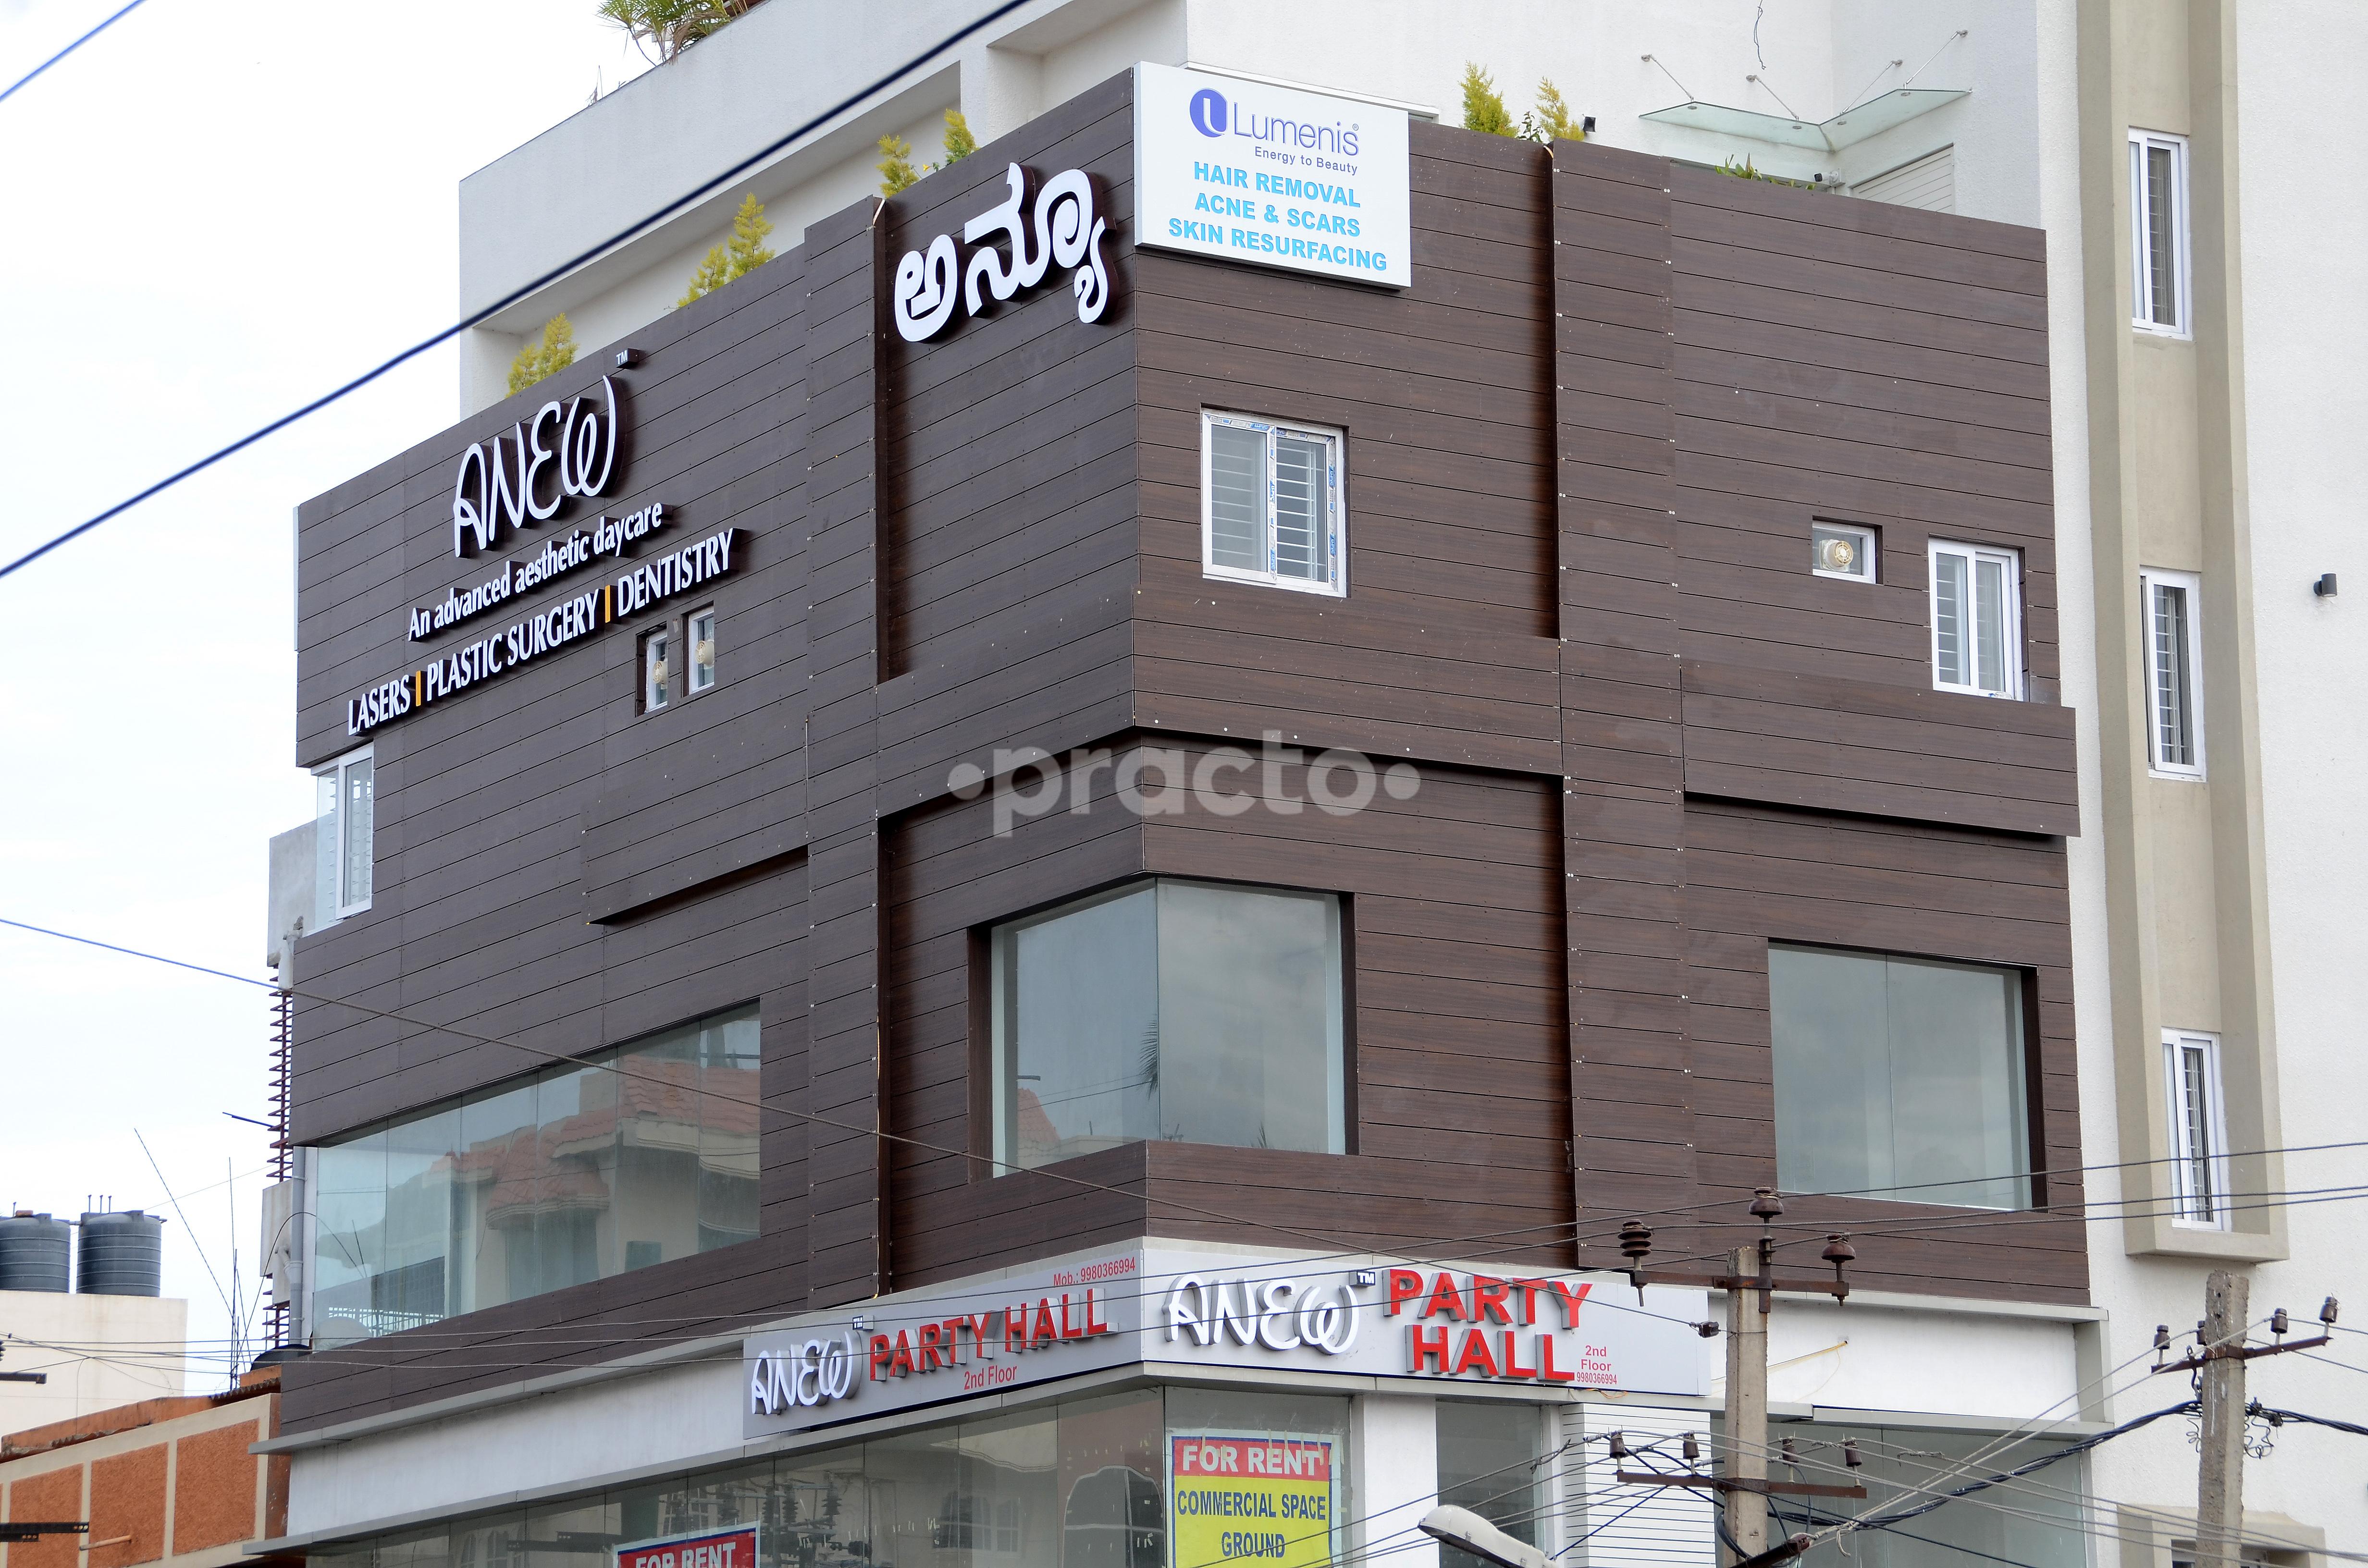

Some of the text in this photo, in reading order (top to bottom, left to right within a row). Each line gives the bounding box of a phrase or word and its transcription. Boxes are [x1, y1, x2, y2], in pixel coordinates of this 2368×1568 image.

[1255, 147, 1357, 176] Energy to Beauty
[1194, 161, 1360, 208] HAIR REMOVAL
[1194, 193, 1360, 237] ACNE & SCARS
[1169, 218, 1387, 271] SKIN RESURFACING
[453, 375, 616, 558] ANEW
[408, 502, 662, 641] An advanced aesthetic daycare
[348, 527, 733, 736] LASERS PLASTIC SURGERY DENTISTRY
[1081, 1256, 1135, 1283] 9980366994
[1165, 1273, 1359, 1356] ANEW
[1386, 1268, 1593, 1330] PARTY
[752, 1331, 853, 1415] ANEW
[870, 1312, 992, 1382] PARTY
[1005, 1288, 1108, 1353] HALL
[1407, 1324, 1575, 1382] HALL
[1581, 1359, 1612, 1371] Floor
[1585, 1345, 1606, 1357] 2nd
[963, 1363, 1018, 1390] 2nd Floor
[1577, 1372, 1617, 1384] 9980366994
[1183, 1445, 1324, 1476] FOR RENT
[1178, 1490, 1326, 1520] COMMERCIAL SPACE
[681, 1542, 736, 1568] RENT
[1221, 1531, 1285, 1558] GROUND
